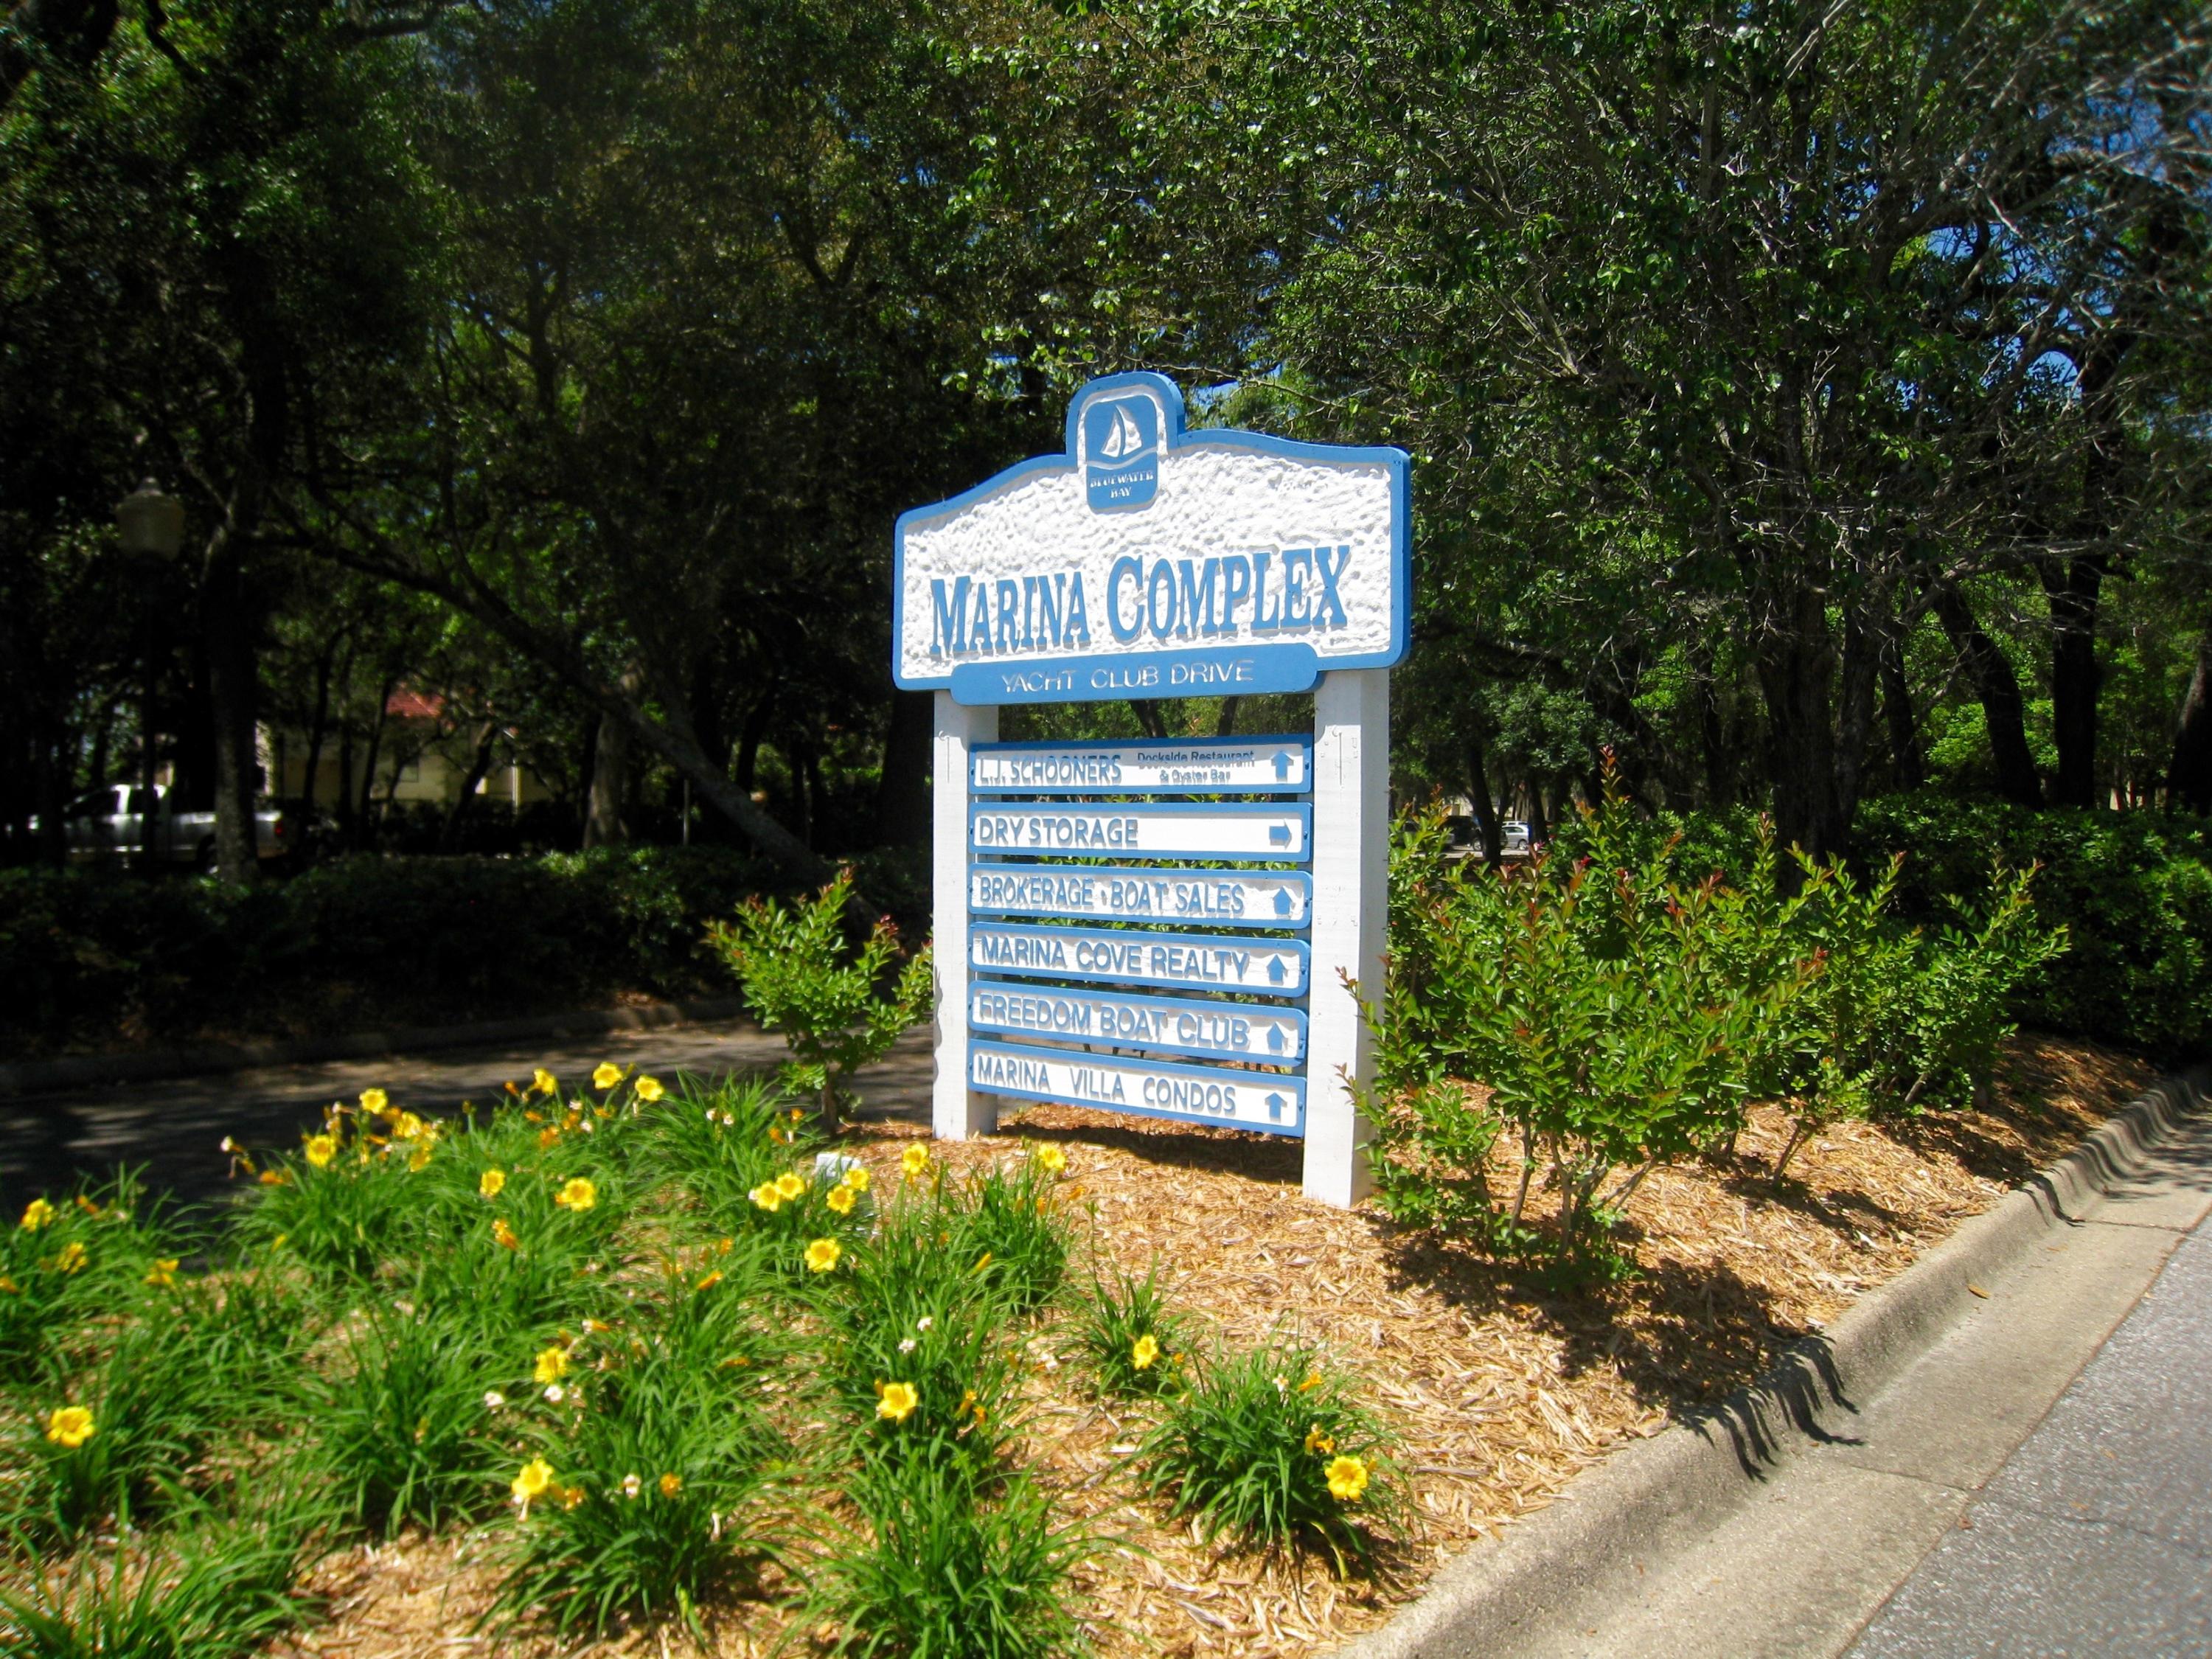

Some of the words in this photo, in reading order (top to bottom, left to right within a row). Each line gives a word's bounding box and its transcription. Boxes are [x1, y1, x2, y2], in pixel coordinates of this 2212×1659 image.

[1110, 486, 1132, 498] BAY
[930, 572, 1091, 657] MARINA
[1107, 544, 1352, 642] COMPLEX
[1001, 669, 1076, 693] YACHT
[1091, 664, 1159, 689] CLUB
[1170, 659, 1254, 685] DRIVE
[1011, 754, 1121, 784] SCHOONERS
[1138, 751, 1188, 762] Dockside
[1192, 749, 1255, 762] Restaurant
[1160, 770, 1169, 780] &
[1172, 769, 1207, 783] Oyster
[1211, 769, 1230, 781] Bar
[979, 818, 1025, 843] DRY
[1030, 817, 1138, 844] STORAGE
[980, 876, 1094, 907] BROKERAGE
[1110, 881, 1164, 911] BOAT
[1175, 883, 1245, 914] SALES
[981, 936, 1066, 967] MARINA
[1076, 941, 1142, 972] COVE
[1151, 945, 1250, 979] REALTY
[979, 994, 1091, 1032] FREEDOM
[1100, 1006, 1167, 1040] BOAT
[1176, 1012, 1251, 1048] CLUB
[978, 1054, 1049, 1088] MARINA
[1069, 1068, 1125, 1100] VILLA
[1143, 1077, 1237, 1112] CONDOS
